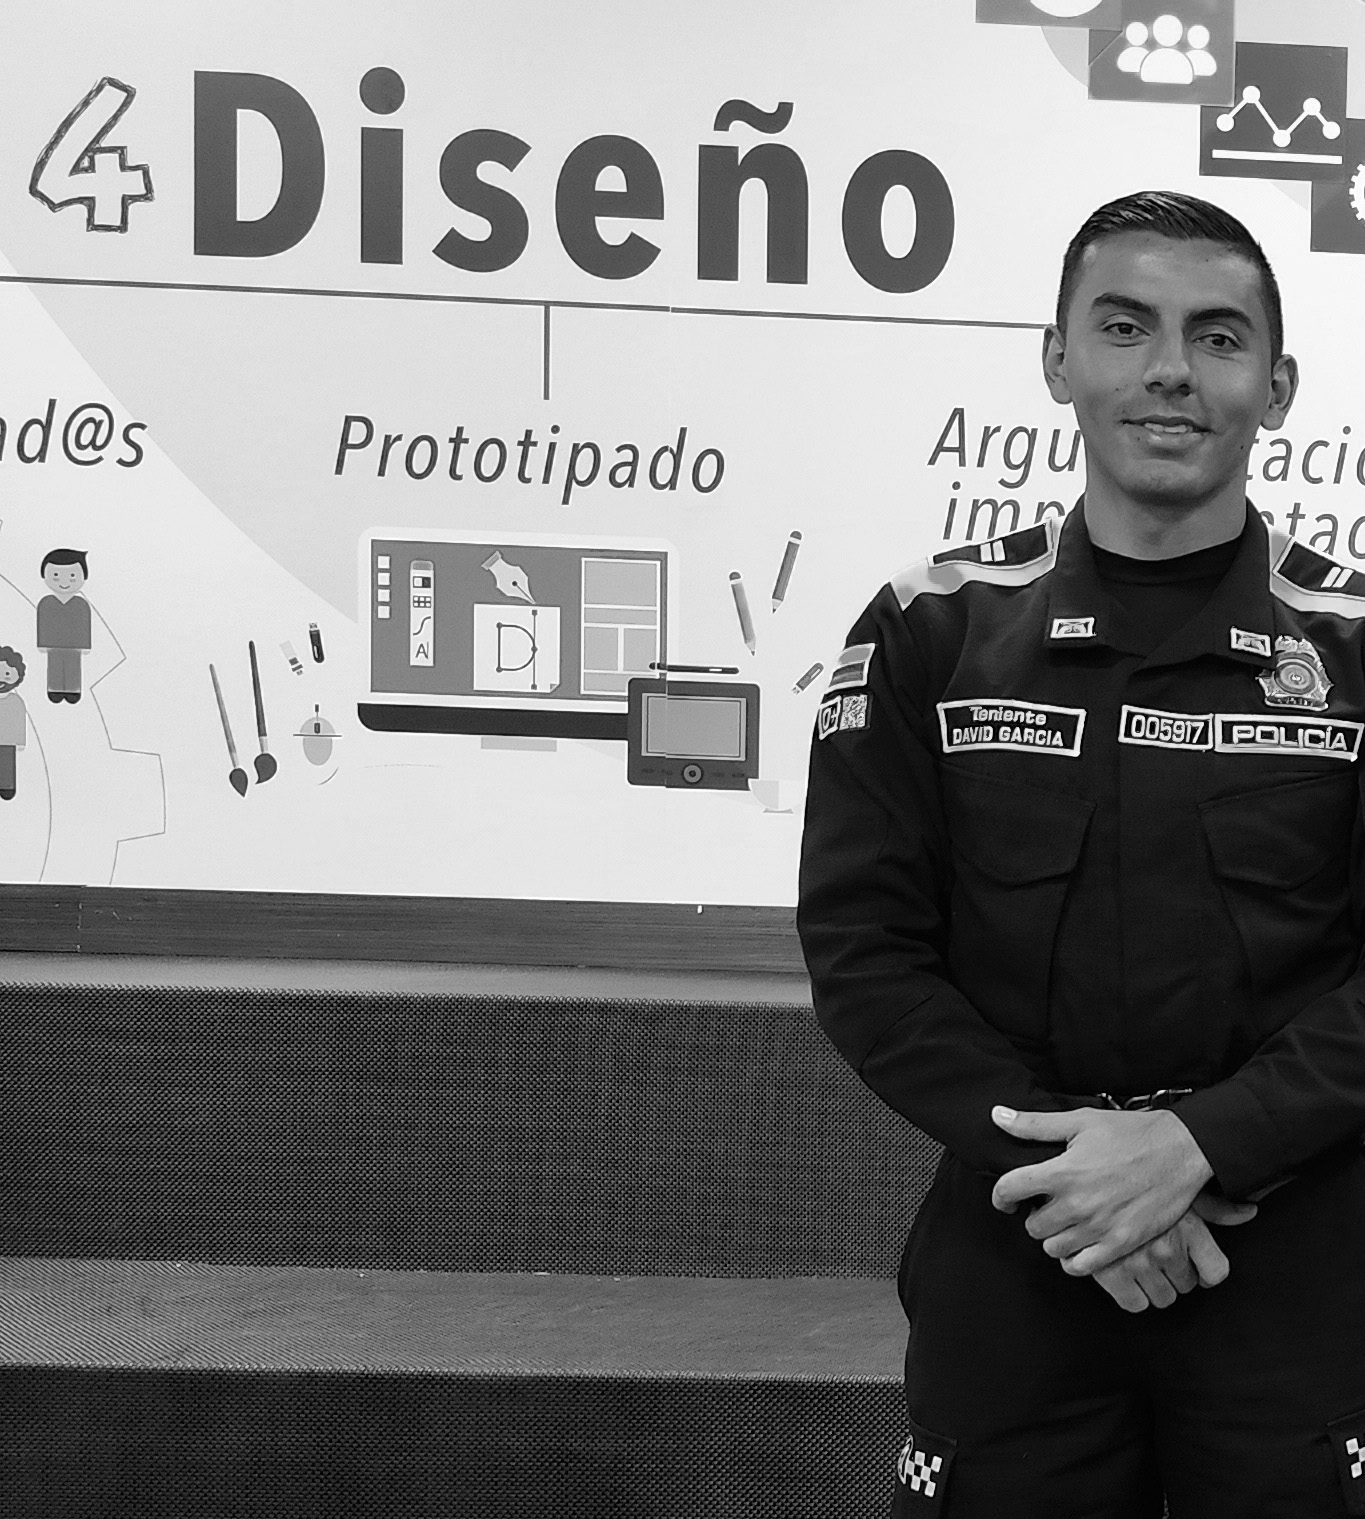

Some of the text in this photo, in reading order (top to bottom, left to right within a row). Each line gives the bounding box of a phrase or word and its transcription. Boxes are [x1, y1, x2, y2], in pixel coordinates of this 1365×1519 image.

[29, 66, 956, 294] 4 Diseño
[0, 398, 148, 468] d@s
[334, 413, 726, 506] Prototipado
[952, 725, 1064, 747] DAVID GARCIA
[969, 706, 1047, 726] Teniente
[1130, 714, 1205, 744] 005917
